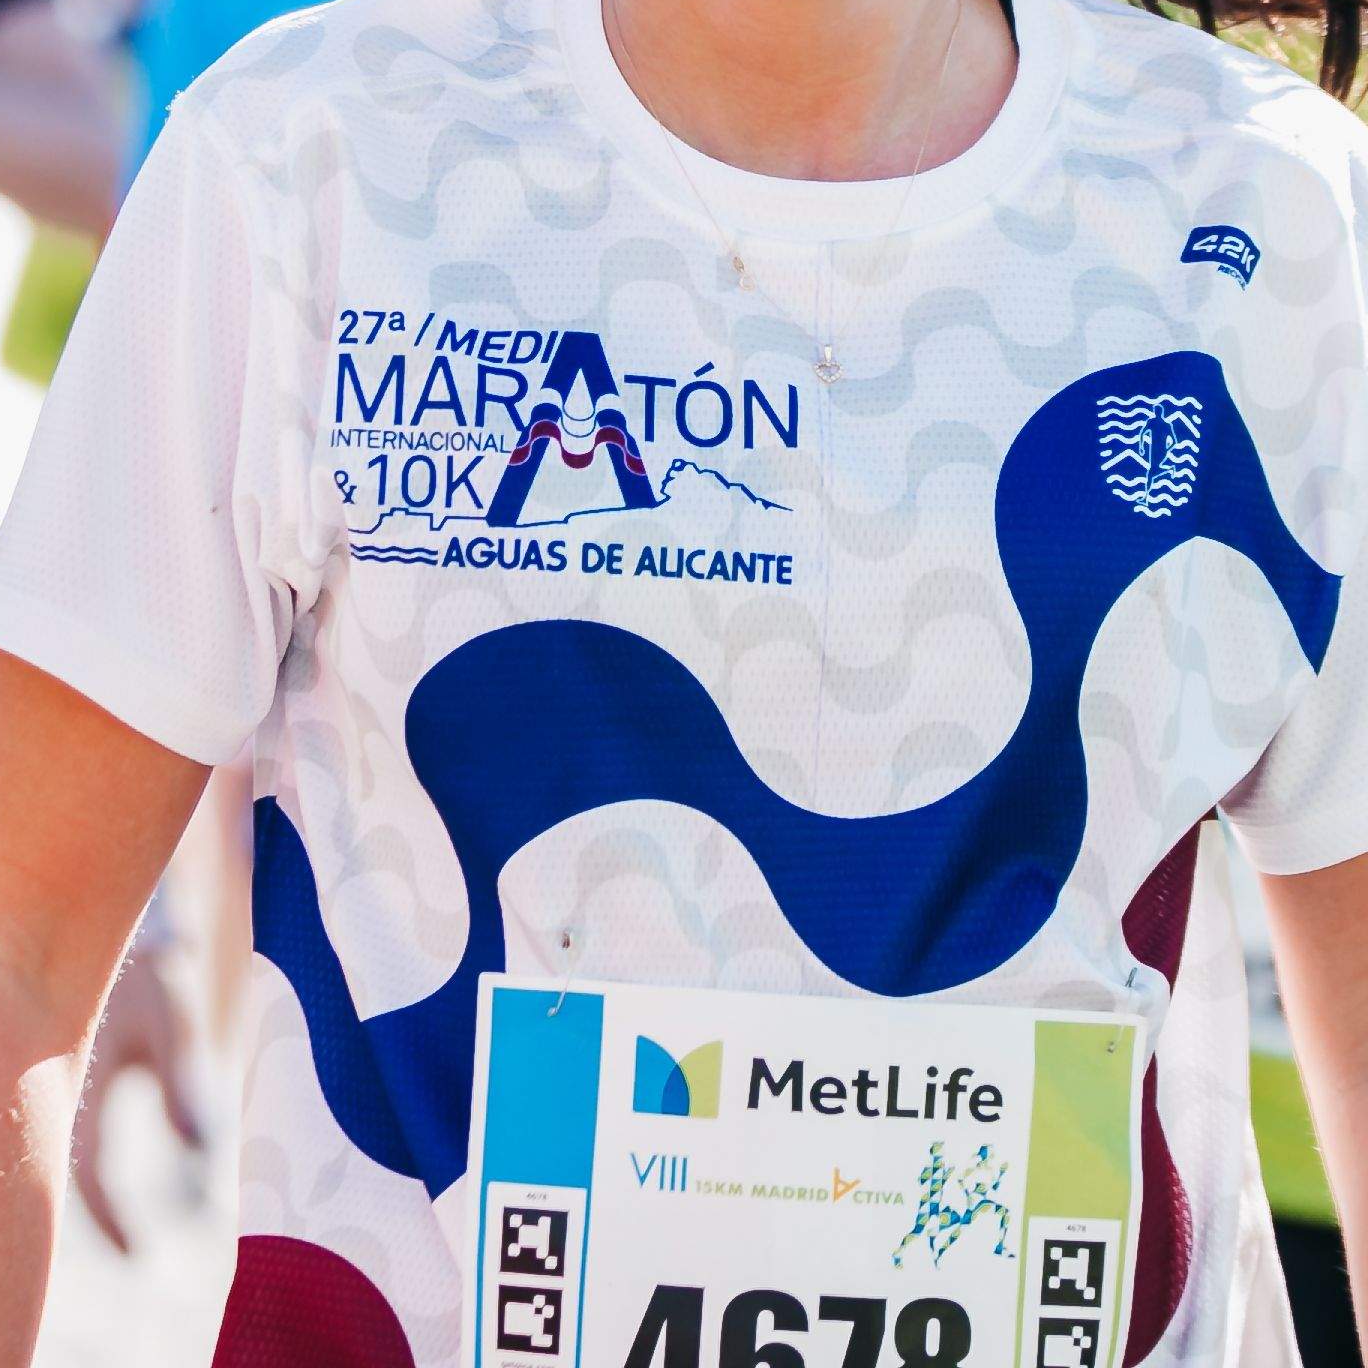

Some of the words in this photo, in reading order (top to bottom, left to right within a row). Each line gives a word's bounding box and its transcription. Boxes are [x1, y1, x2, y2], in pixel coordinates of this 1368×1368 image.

[330, 428, 512, 454] INTERNACIONAL
[333, 470, 358, 505] &
[367, 454, 485, 509] 10K
[441, 536, 569, 572] AGUAS
[581, 542, 625, 575] DE
[632, 545, 793, 585] ALICANTE
[747, 1057, 1004, 1123] MetLife
[630, 1151, 688, 1192] VIII
[695, 1180, 744, 1196] 15KM
[750, 1181, 829, 1202] MADRID
